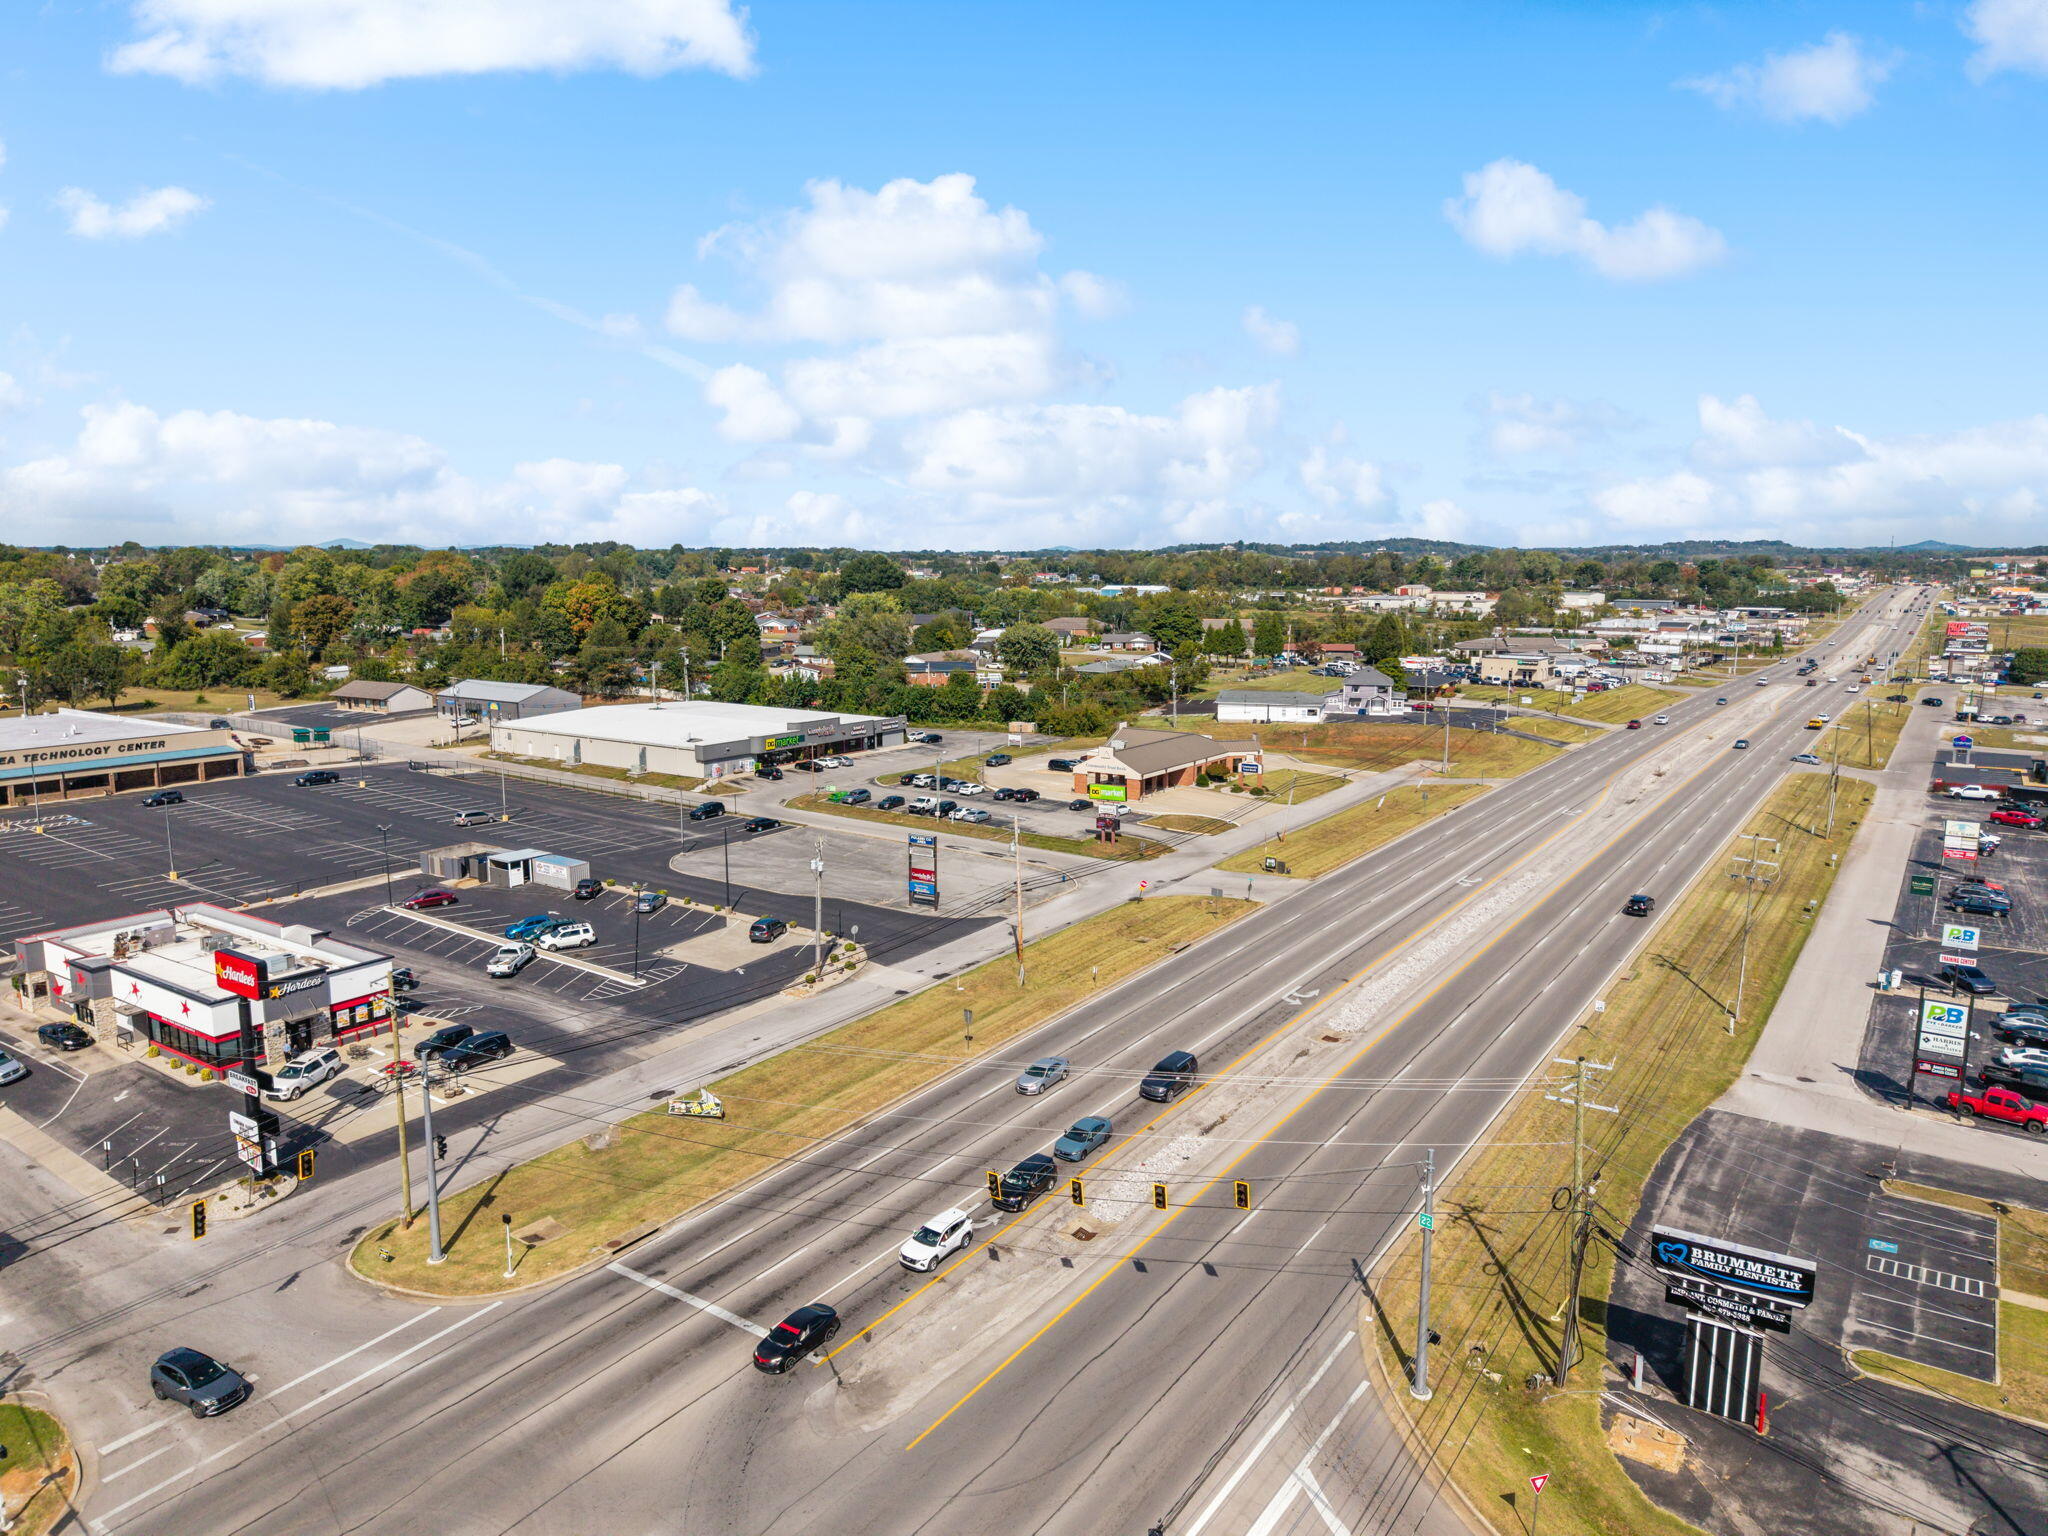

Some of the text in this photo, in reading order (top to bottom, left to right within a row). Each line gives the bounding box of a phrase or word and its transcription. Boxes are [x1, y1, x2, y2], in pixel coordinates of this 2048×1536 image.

[23, 746, 110, 762] TECHNOLOGY
[118, 740, 165, 753] CENTER
[775, 735, 799, 748] market
[1101, 789, 1124, 797] market
[1941, 955, 1959, 963] TRAINING
[222, 966, 255, 987] Hardee's
[278, 976, 321, 996] Hardee's
[1933, 1037, 1961, 1046] HARRIS
[229, 1071, 257, 1087] BREAKFAST
[1690, 1258, 1802, 1290] FAMILY DENTISTRY
[1691, 1247, 1802, 1283] BRUMMETT
[1707, 1296, 1748, 1311] COSMETIC
[1749, 1307, 1756, 1315] &
